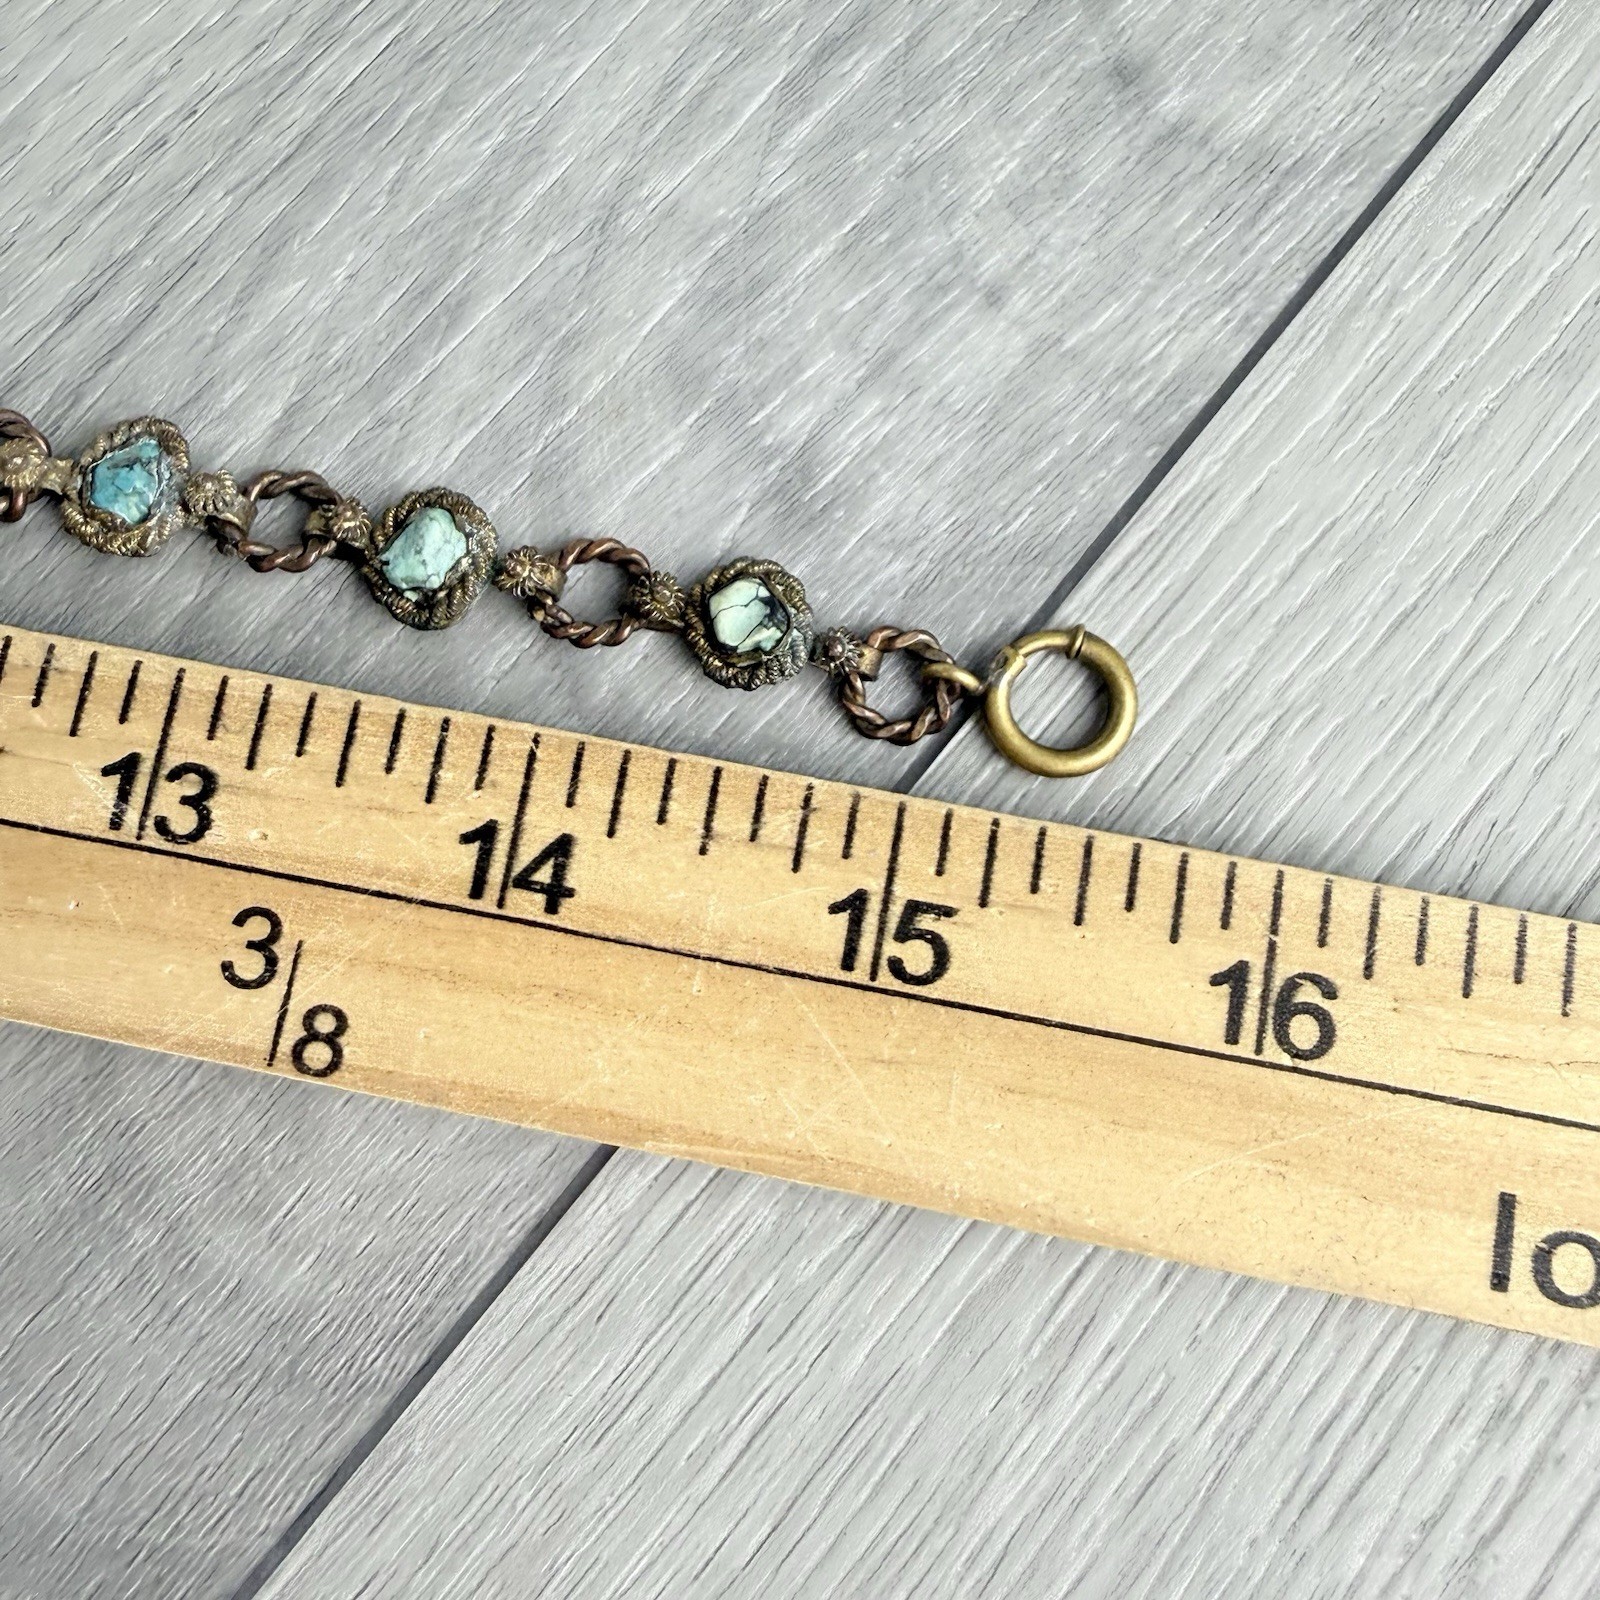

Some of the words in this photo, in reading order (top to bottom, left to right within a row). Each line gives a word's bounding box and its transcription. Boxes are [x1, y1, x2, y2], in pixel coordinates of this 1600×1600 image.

[101, 752, 218, 843] 13
[459, 820, 576, 914] 14
[828, 888, 959, 986] 15
[1209, 959, 1339, 1061] 16
